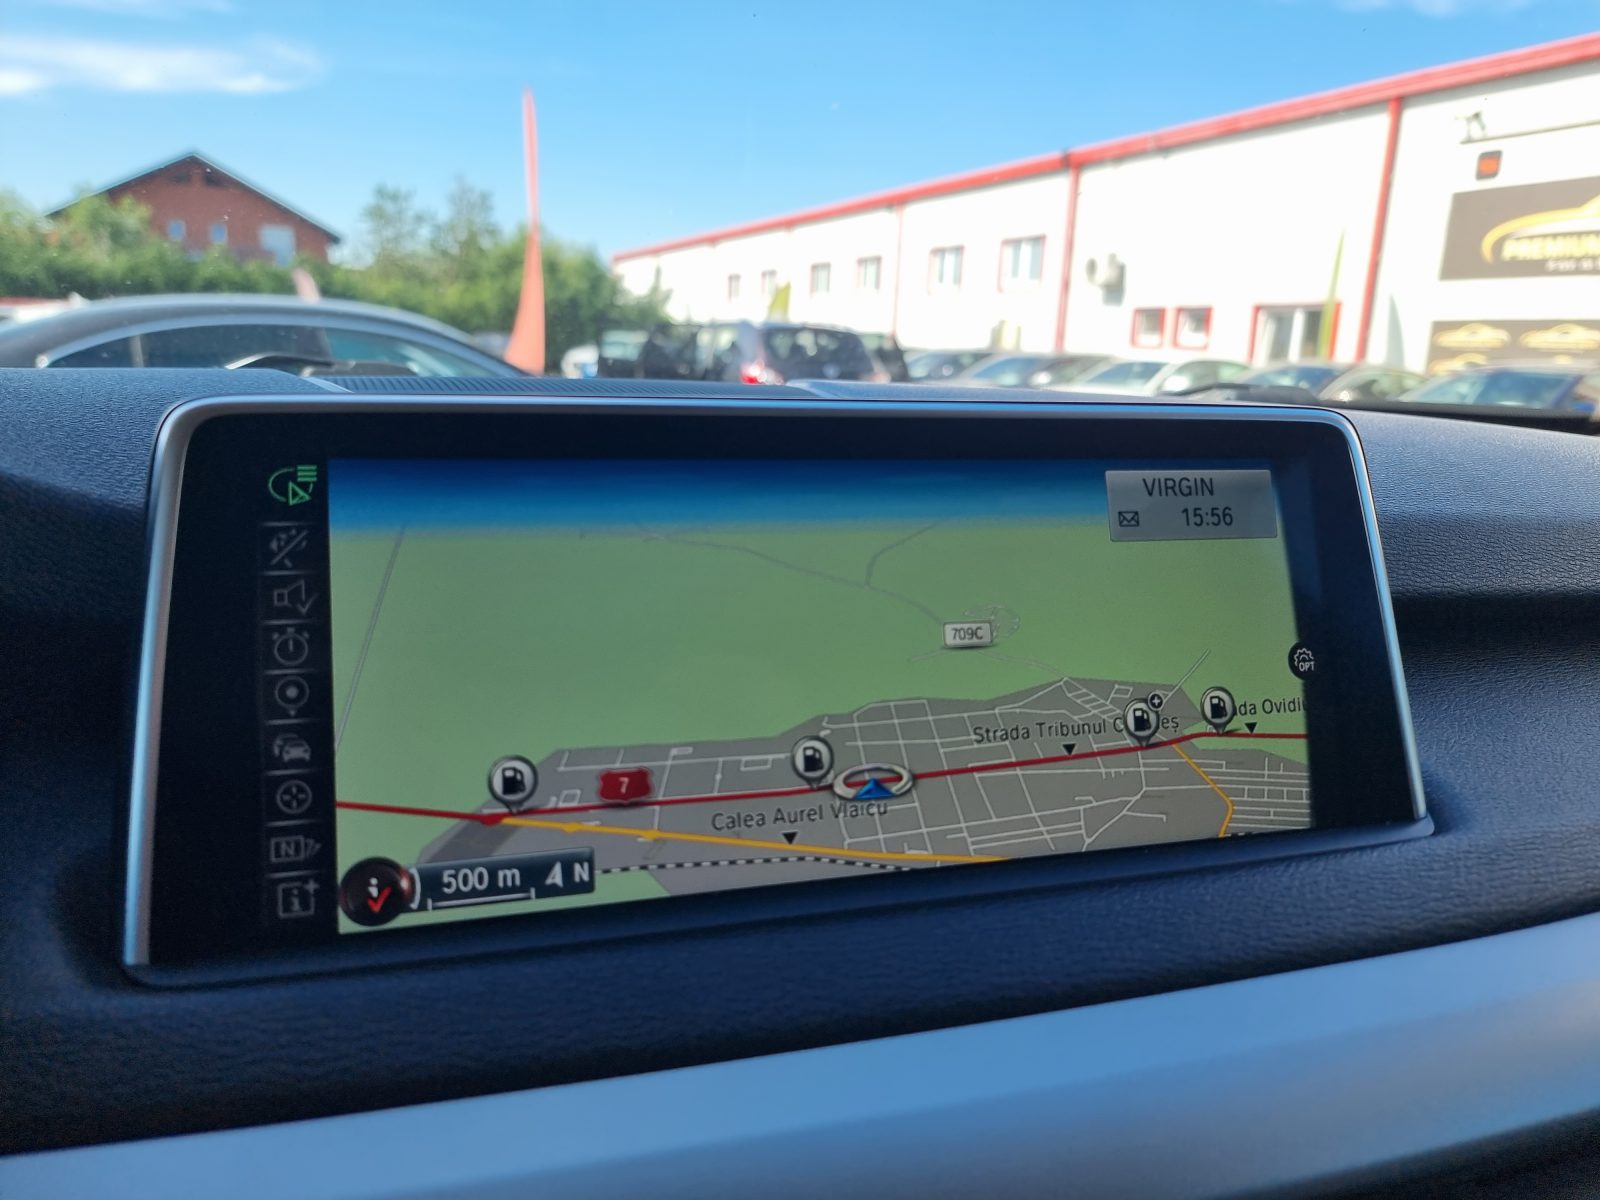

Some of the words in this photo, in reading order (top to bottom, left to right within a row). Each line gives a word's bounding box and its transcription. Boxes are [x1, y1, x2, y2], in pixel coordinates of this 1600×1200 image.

[1142, 477, 1214, 497] VIRGIN
[1181, 506, 1234, 528] 15:56
[951, 626, 984, 641] 709C
[1298, 660, 1315, 671] OPT
[973, 721, 1030, 744] Strada
[1036, 715, 1107, 739] Tribunul
[619, 776, 629, 793] 7
[712, 811, 766, 831] Calea
[773, 804, 824, 825] Aurel
[830, 800, 888, 819] Vlaicu
[442, 867, 489, 894] 500
[499, 868, 521, 888] m
[574, 862, 590, 883] N
